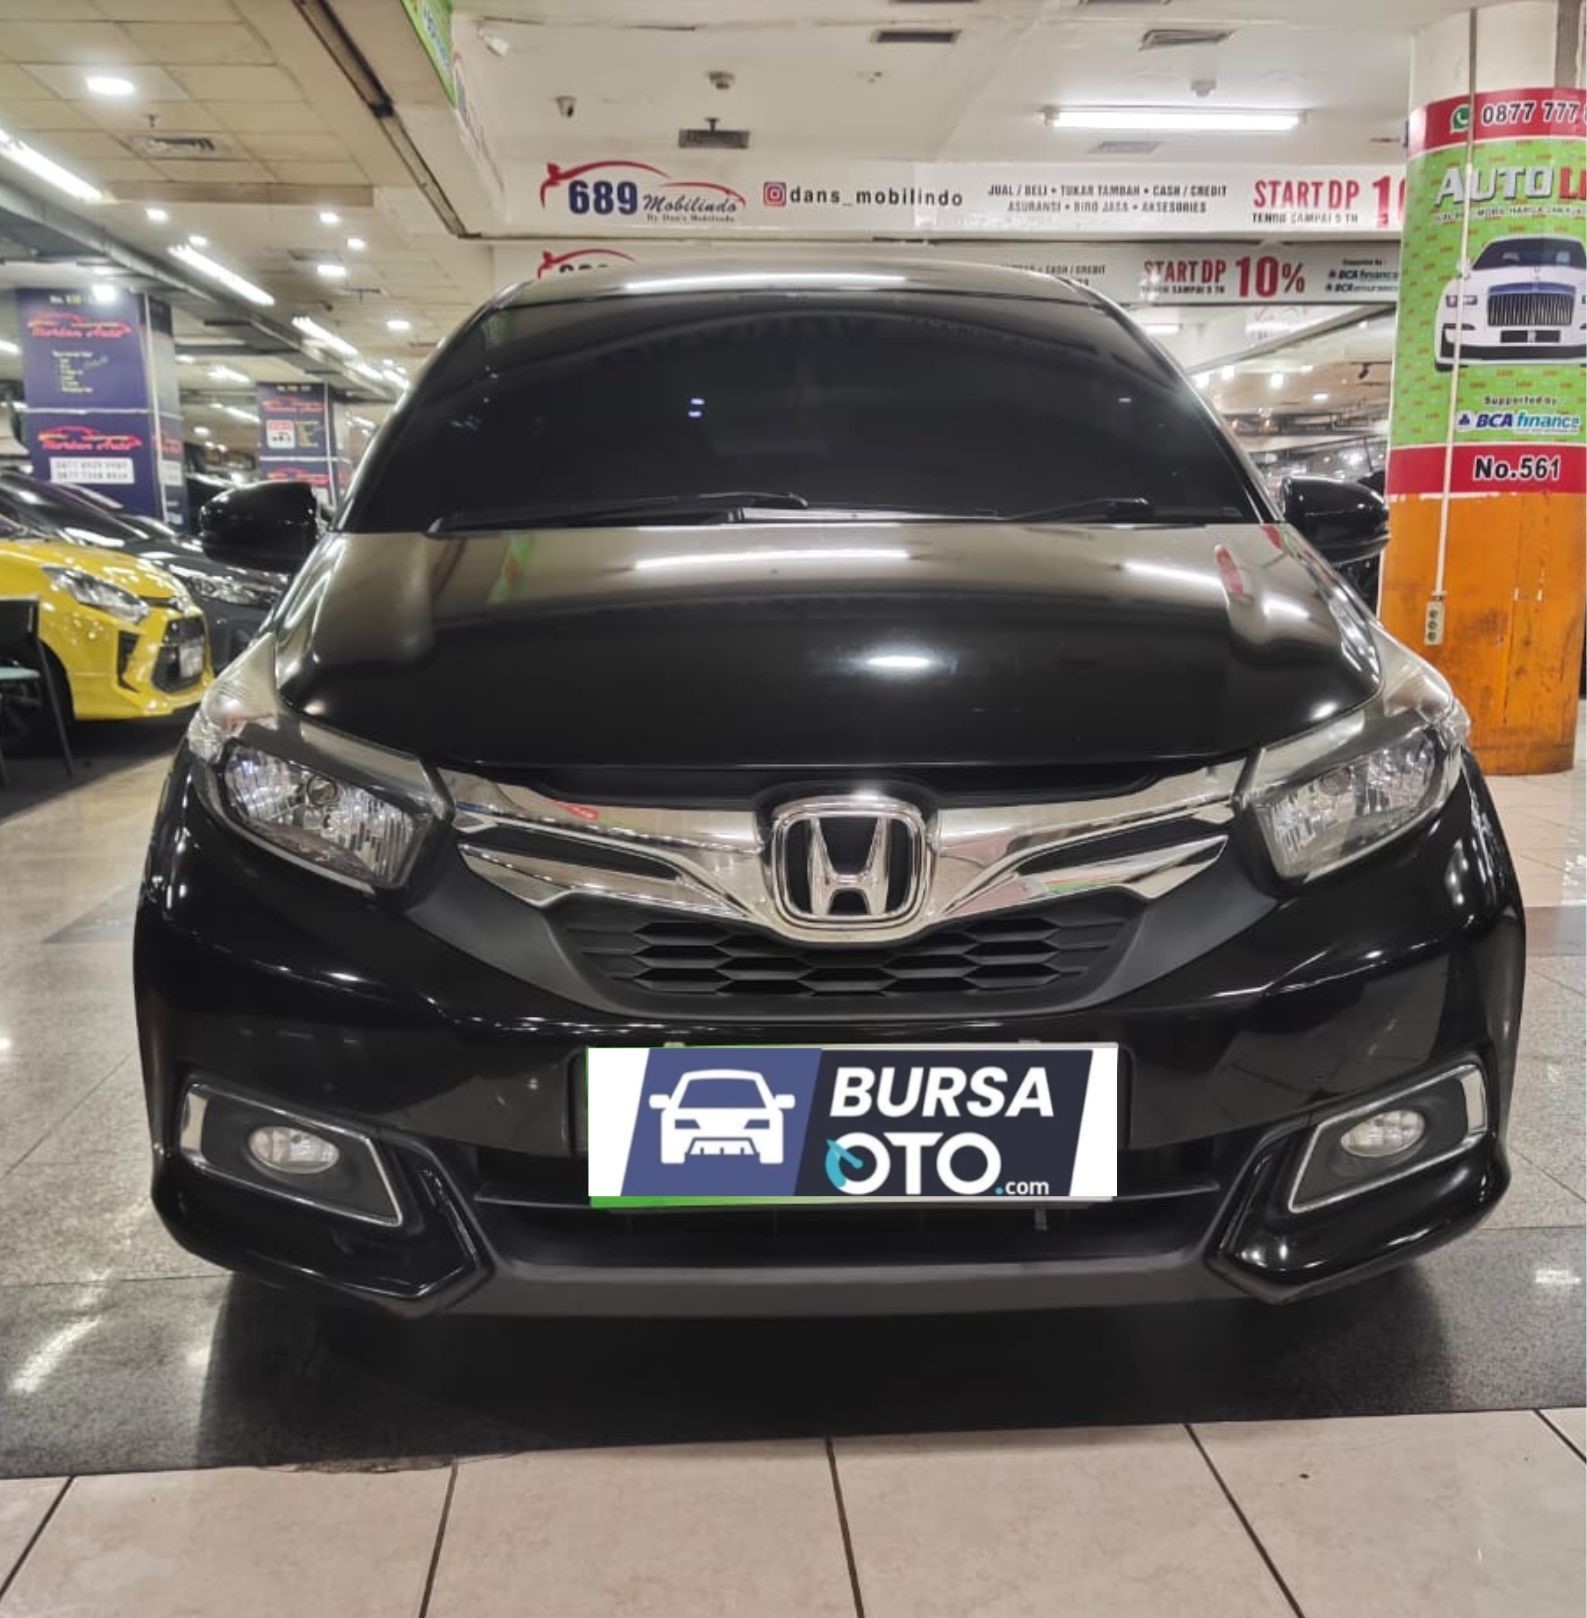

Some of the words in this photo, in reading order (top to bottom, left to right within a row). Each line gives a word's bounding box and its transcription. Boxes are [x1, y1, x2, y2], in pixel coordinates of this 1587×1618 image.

[1483, 103, 1535, 126] 0877
[1544, 102, 1579, 122] 777
[568, 180, 637, 214] 689
[790, 186, 963, 206] dans_mobilindo
[988, 184, 1014, 196] JUAL
[1025, 185, 1047, 196] BELI
[1060, 184, 1094, 196] TUKAR
[1098, 184, 1140, 196] TAMBAH
[1153, 185, 1181, 196] CASH
[1191, 185, 1227, 197] CREDIT
[1253, 180, 1323, 208] START
[1328, 180, 1360, 210] DP
[643, 194, 737, 213] Mobilindo
[1008, 201, 1061, 213] ASURANSI
[1076, 264, 1106, 275] CREDIT
[1201, 259, 1226, 283] DP
[1235, 256, 1306, 298] 10%
[1476, 413, 1513, 428] BCA
[1517, 412, 1579, 428] finance
[1474, 457, 1560, 480] No.561
